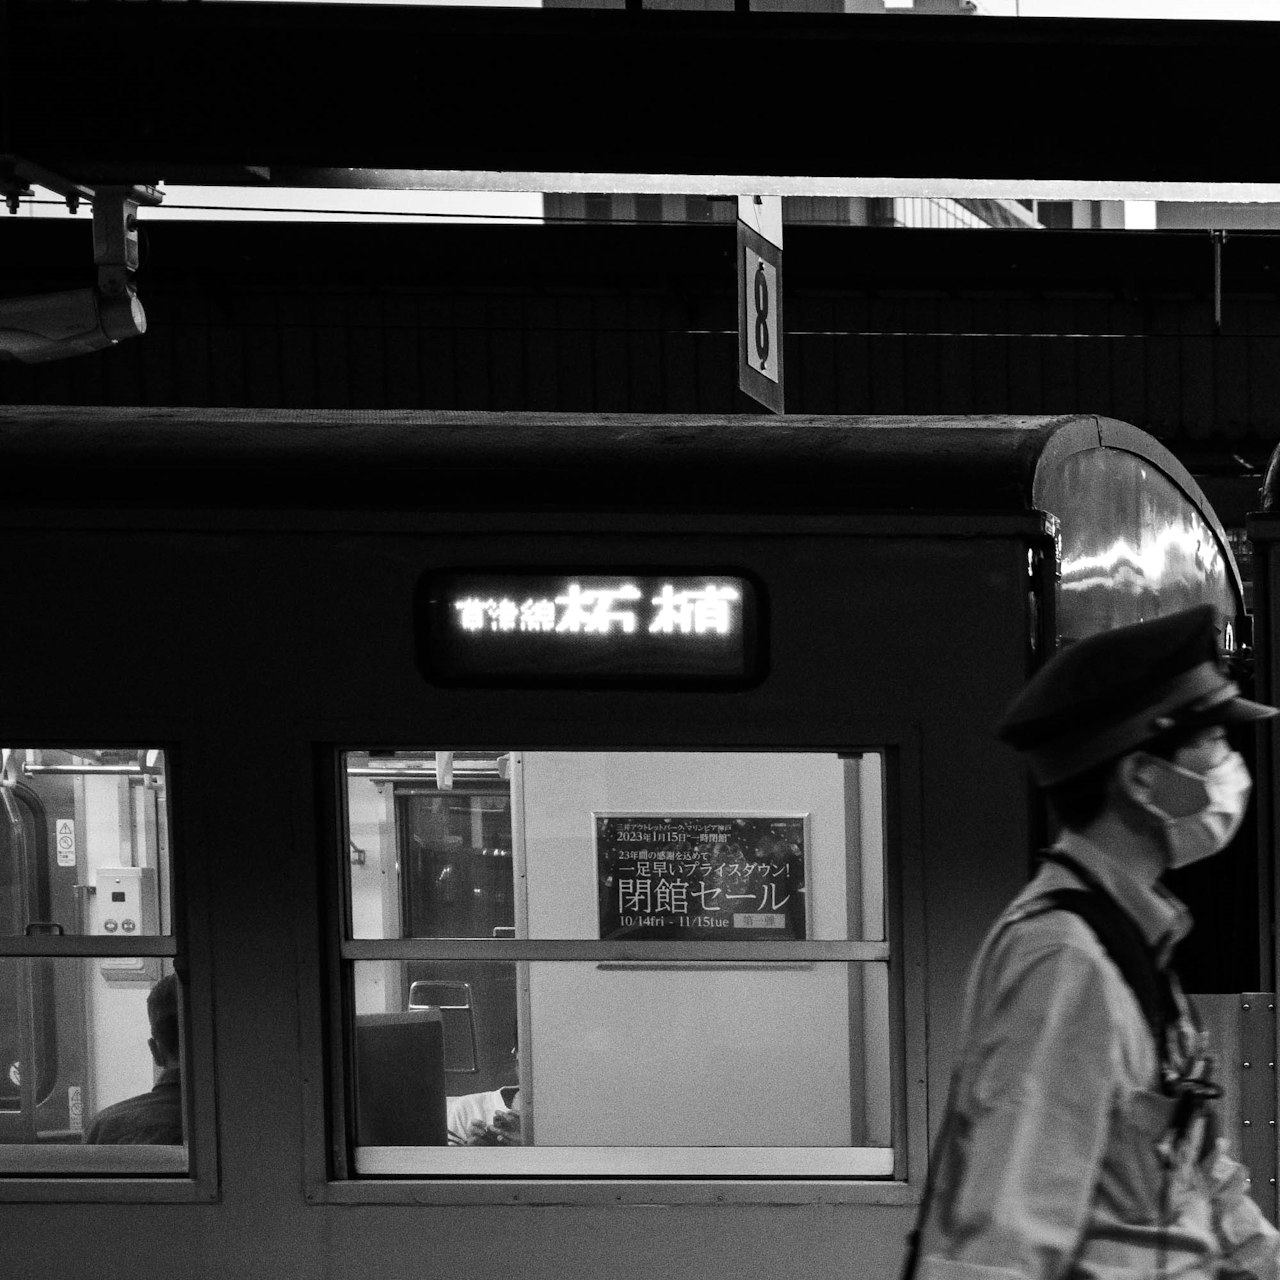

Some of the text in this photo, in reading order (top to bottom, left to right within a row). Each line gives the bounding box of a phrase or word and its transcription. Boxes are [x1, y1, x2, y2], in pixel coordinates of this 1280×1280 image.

[754, 268, 770, 363] 8
[617, 877, 791, 914] 閉館セール
[619, 915, 665, 928] 10/14fri
[679, 915, 730, 928] 11/15tue
